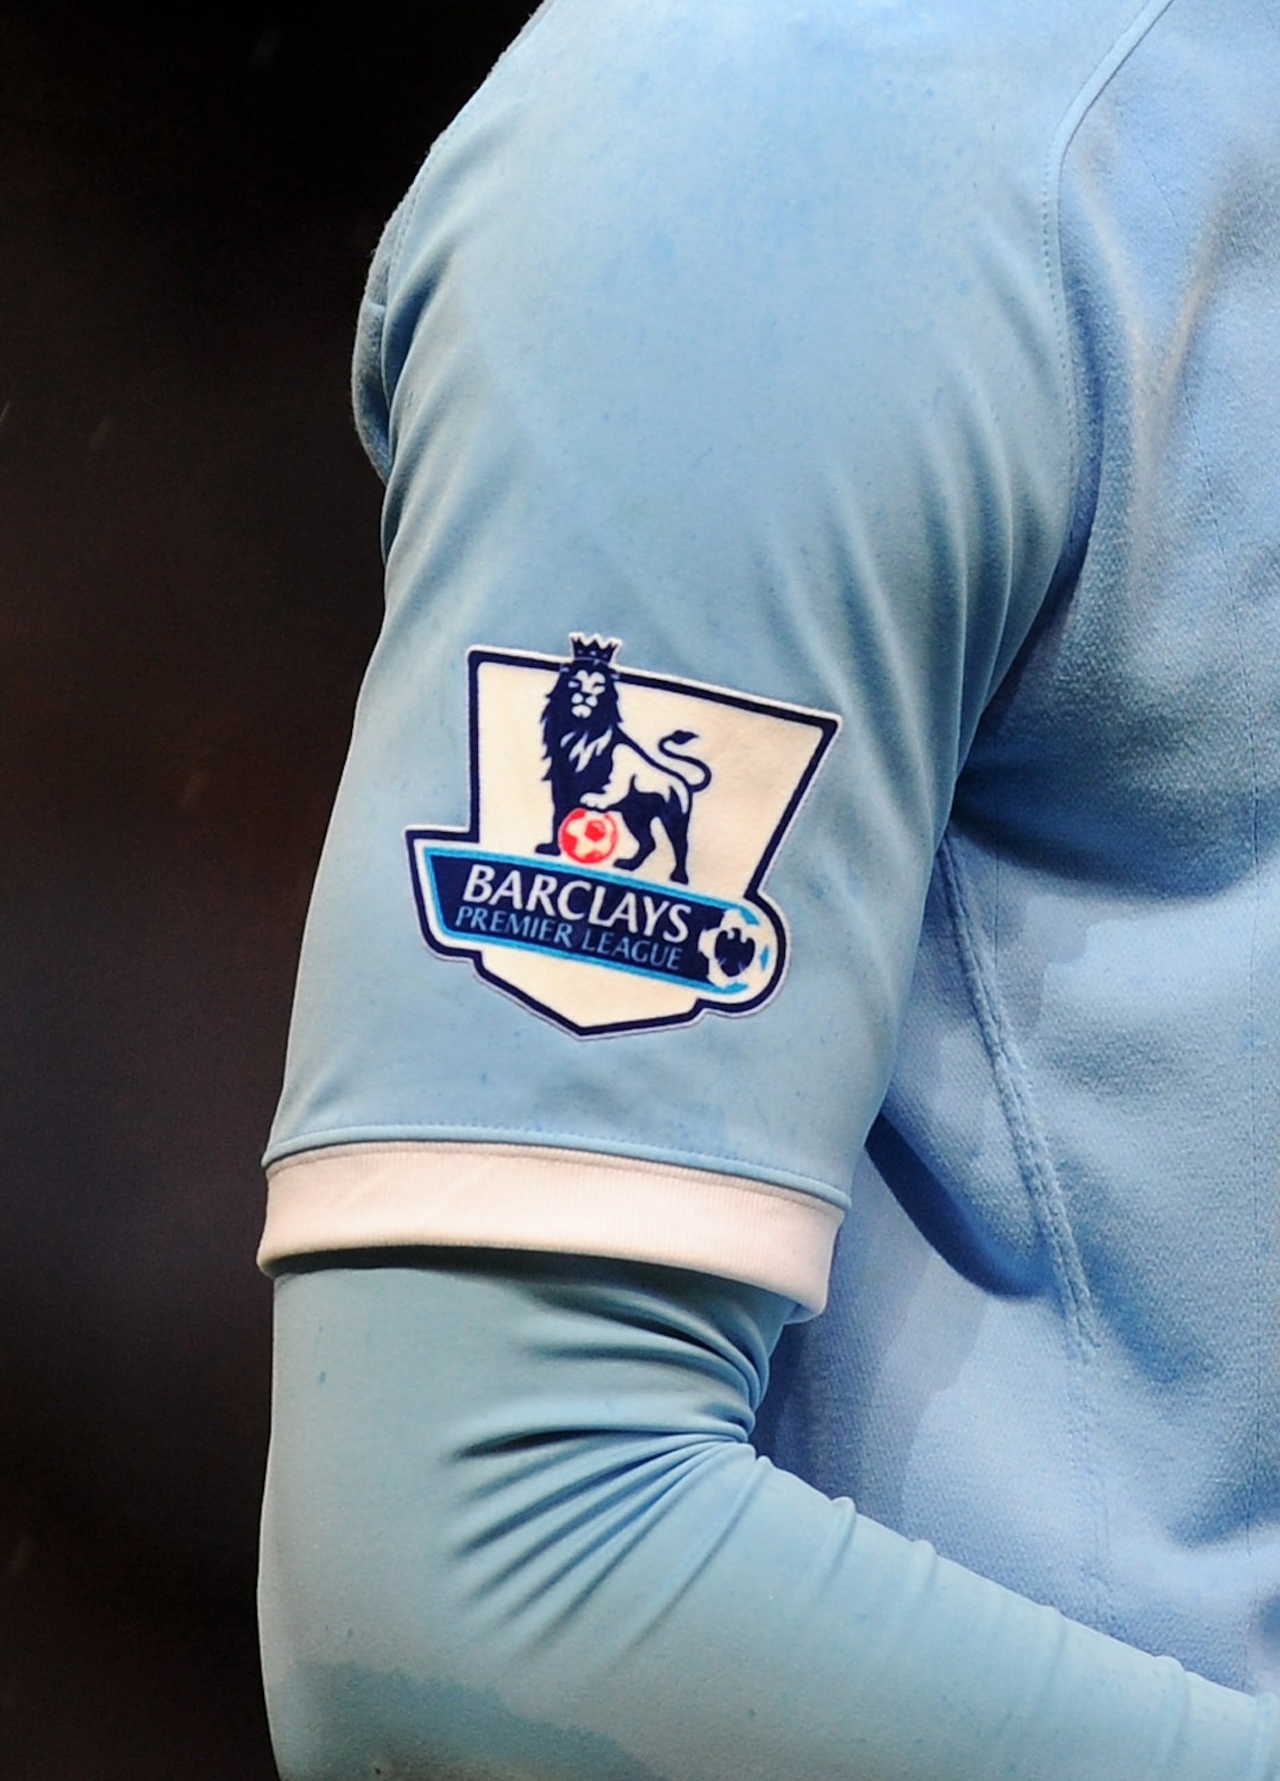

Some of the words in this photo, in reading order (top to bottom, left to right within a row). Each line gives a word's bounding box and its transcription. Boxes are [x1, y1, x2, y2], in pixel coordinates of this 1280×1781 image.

[455, 905, 574, 949] PREMIER
[581, 928, 684, 971] LEAGUE
[462, 863, 692, 944] BARCLAYS
